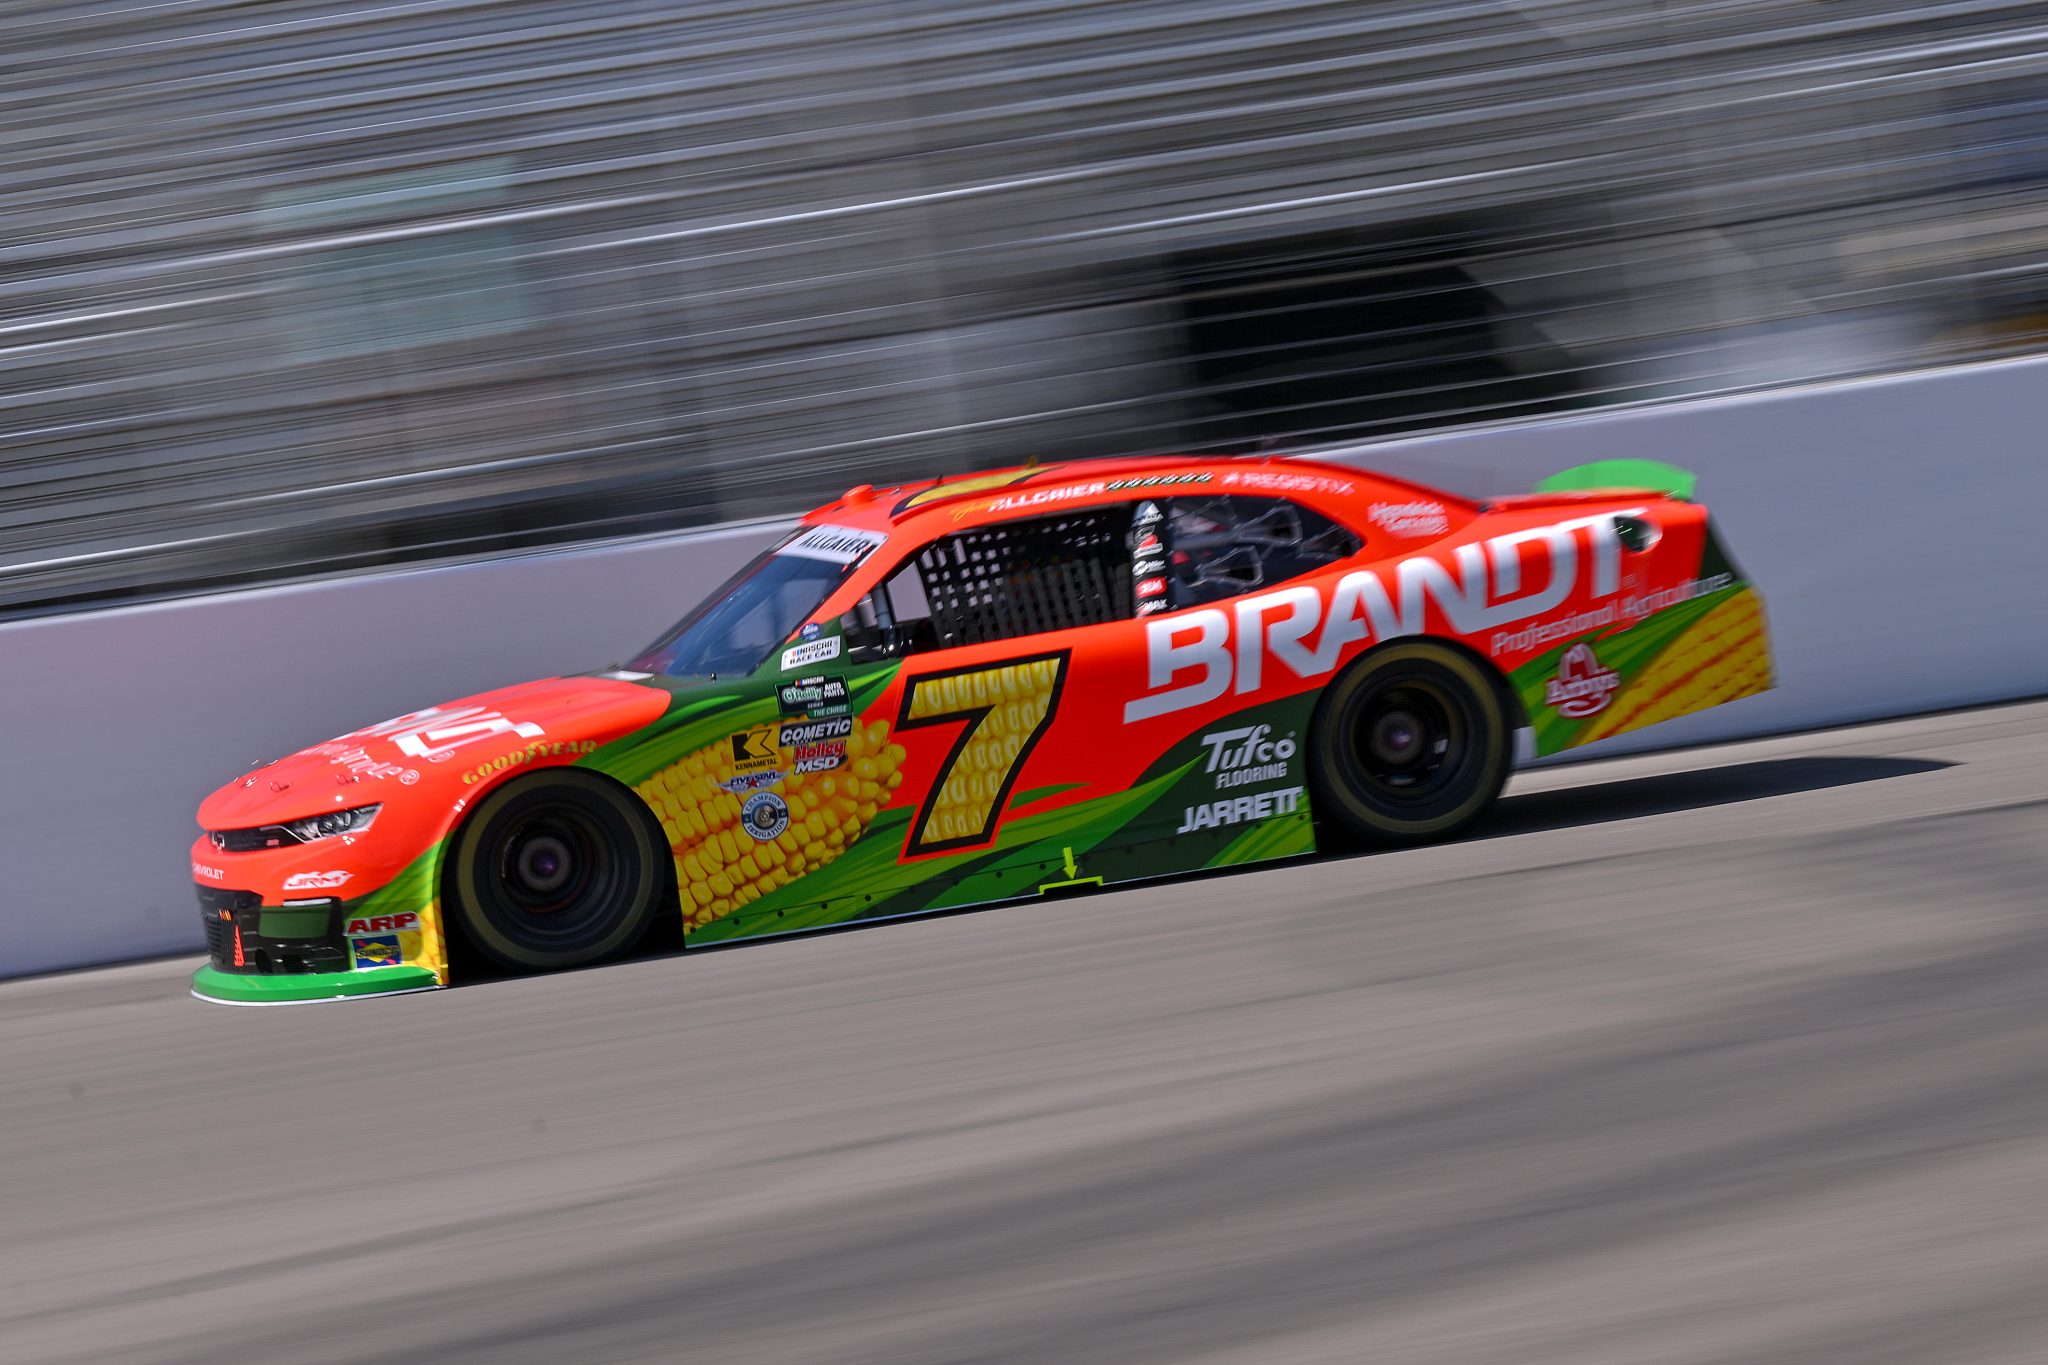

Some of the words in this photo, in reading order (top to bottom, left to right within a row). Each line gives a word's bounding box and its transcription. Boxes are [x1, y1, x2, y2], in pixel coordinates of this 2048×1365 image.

[1123, 507, 1648, 725] BRANDT
[1490, 597, 1619, 657] Professional
[789, 654, 813, 665] RACE
[814, 649, 832, 658] CAR
[799, 640, 833, 655] NASCAR
[782, 686, 822, 703] O'Reilly
[824, 682, 842, 691] AUTO
[824, 688, 845, 699] PARTS
[813, 708, 826, 717] THE
[826, 705, 848, 715] CHASE
[780, 719, 851, 743] COMETIC
[794, 741, 845, 763] Holley
[894, 647, 1073, 859] 7
[1200, 723, 1297, 774] Tufco
[462, 739, 598, 785] GOODYEAR
[735, 758, 778, 771] KENNAMETAL
[794, 755, 841, 776] MSD
[1215, 761, 1288, 790] FLOORING
[745, 795, 782, 812] CHAMPION
[1176, 785, 1304, 834] JARRETT
[746, 819, 786, 839] IRRIGATION
[347, 911, 418, 933] ARP
